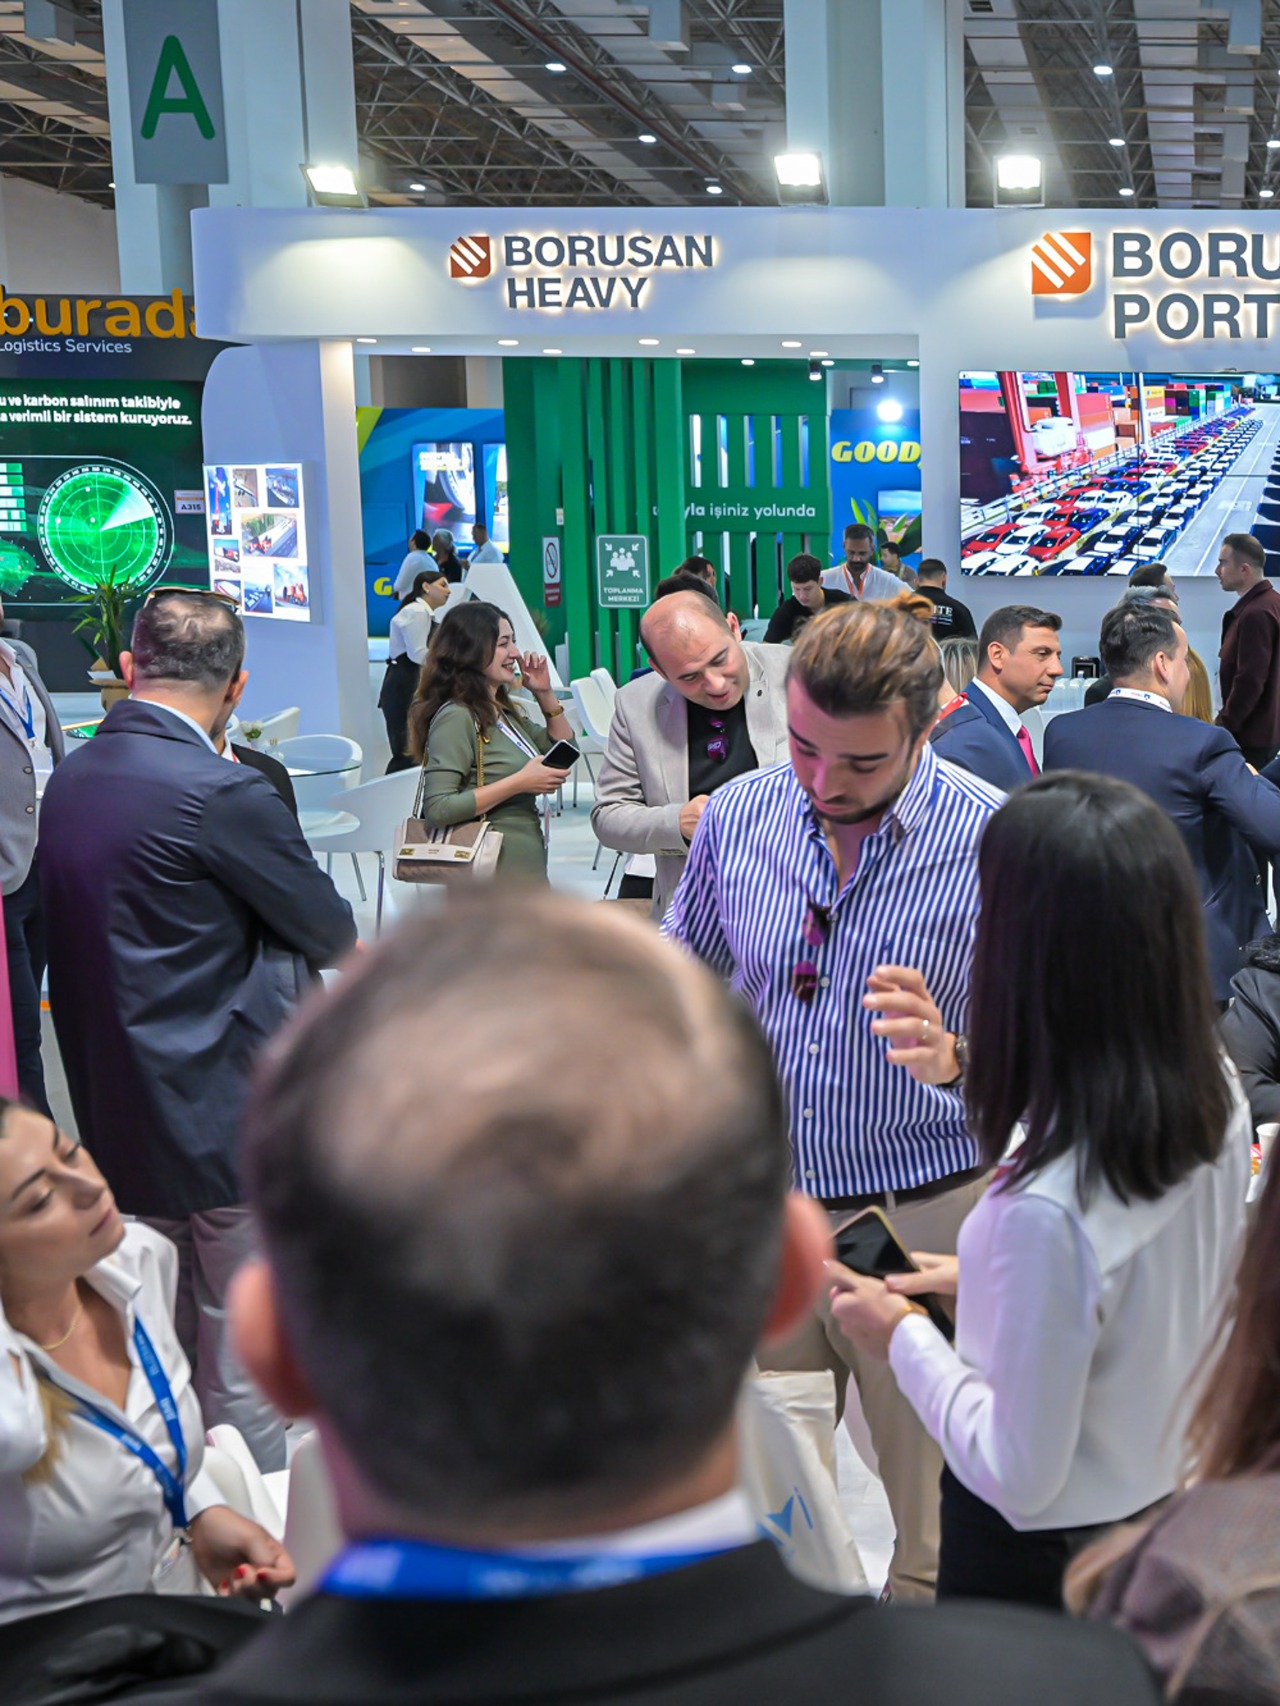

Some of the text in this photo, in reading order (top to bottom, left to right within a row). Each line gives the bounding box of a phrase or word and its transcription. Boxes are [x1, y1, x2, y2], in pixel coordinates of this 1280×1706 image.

[140, 34, 216, 140] A
[504, 235, 713, 267] BORUSAN
[507, 277, 648, 308] HEAVY
[0, 285, 197, 339] burad
[1113, 293, 1280, 339] PORT
[65, 338, 132, 353] Services
[8, 396, 22, 406] ve
[23, 394, 68, 406] karbon
[53, 410, 72, 422] bir
[710, 503, 749, 519] işiniz
[754, 504, 816, 520] yolunda
